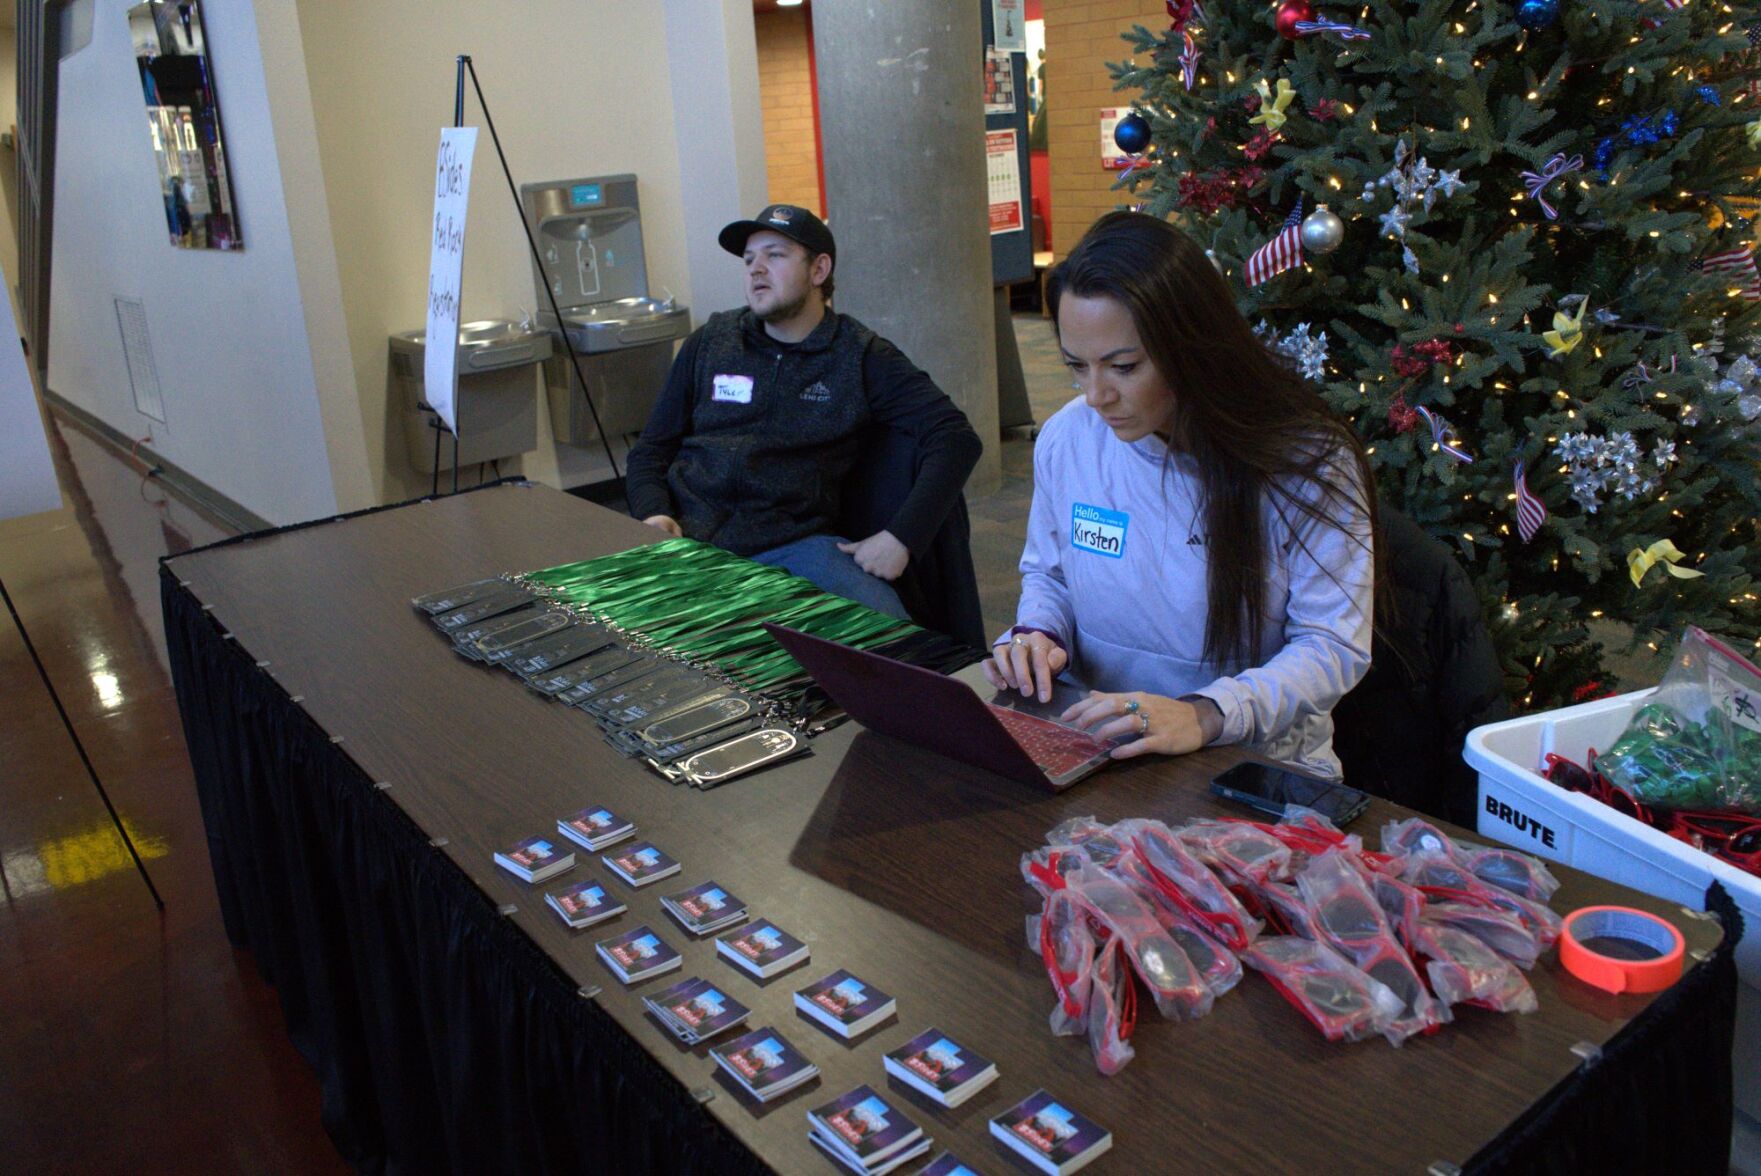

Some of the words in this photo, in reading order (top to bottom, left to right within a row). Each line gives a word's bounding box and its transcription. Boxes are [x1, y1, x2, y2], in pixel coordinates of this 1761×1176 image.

[1074, 505, 1100, 521] Hello
[1073, 521, 1120, 553] Kirsten
[1485, 794, 1556, 850] BRUTE
